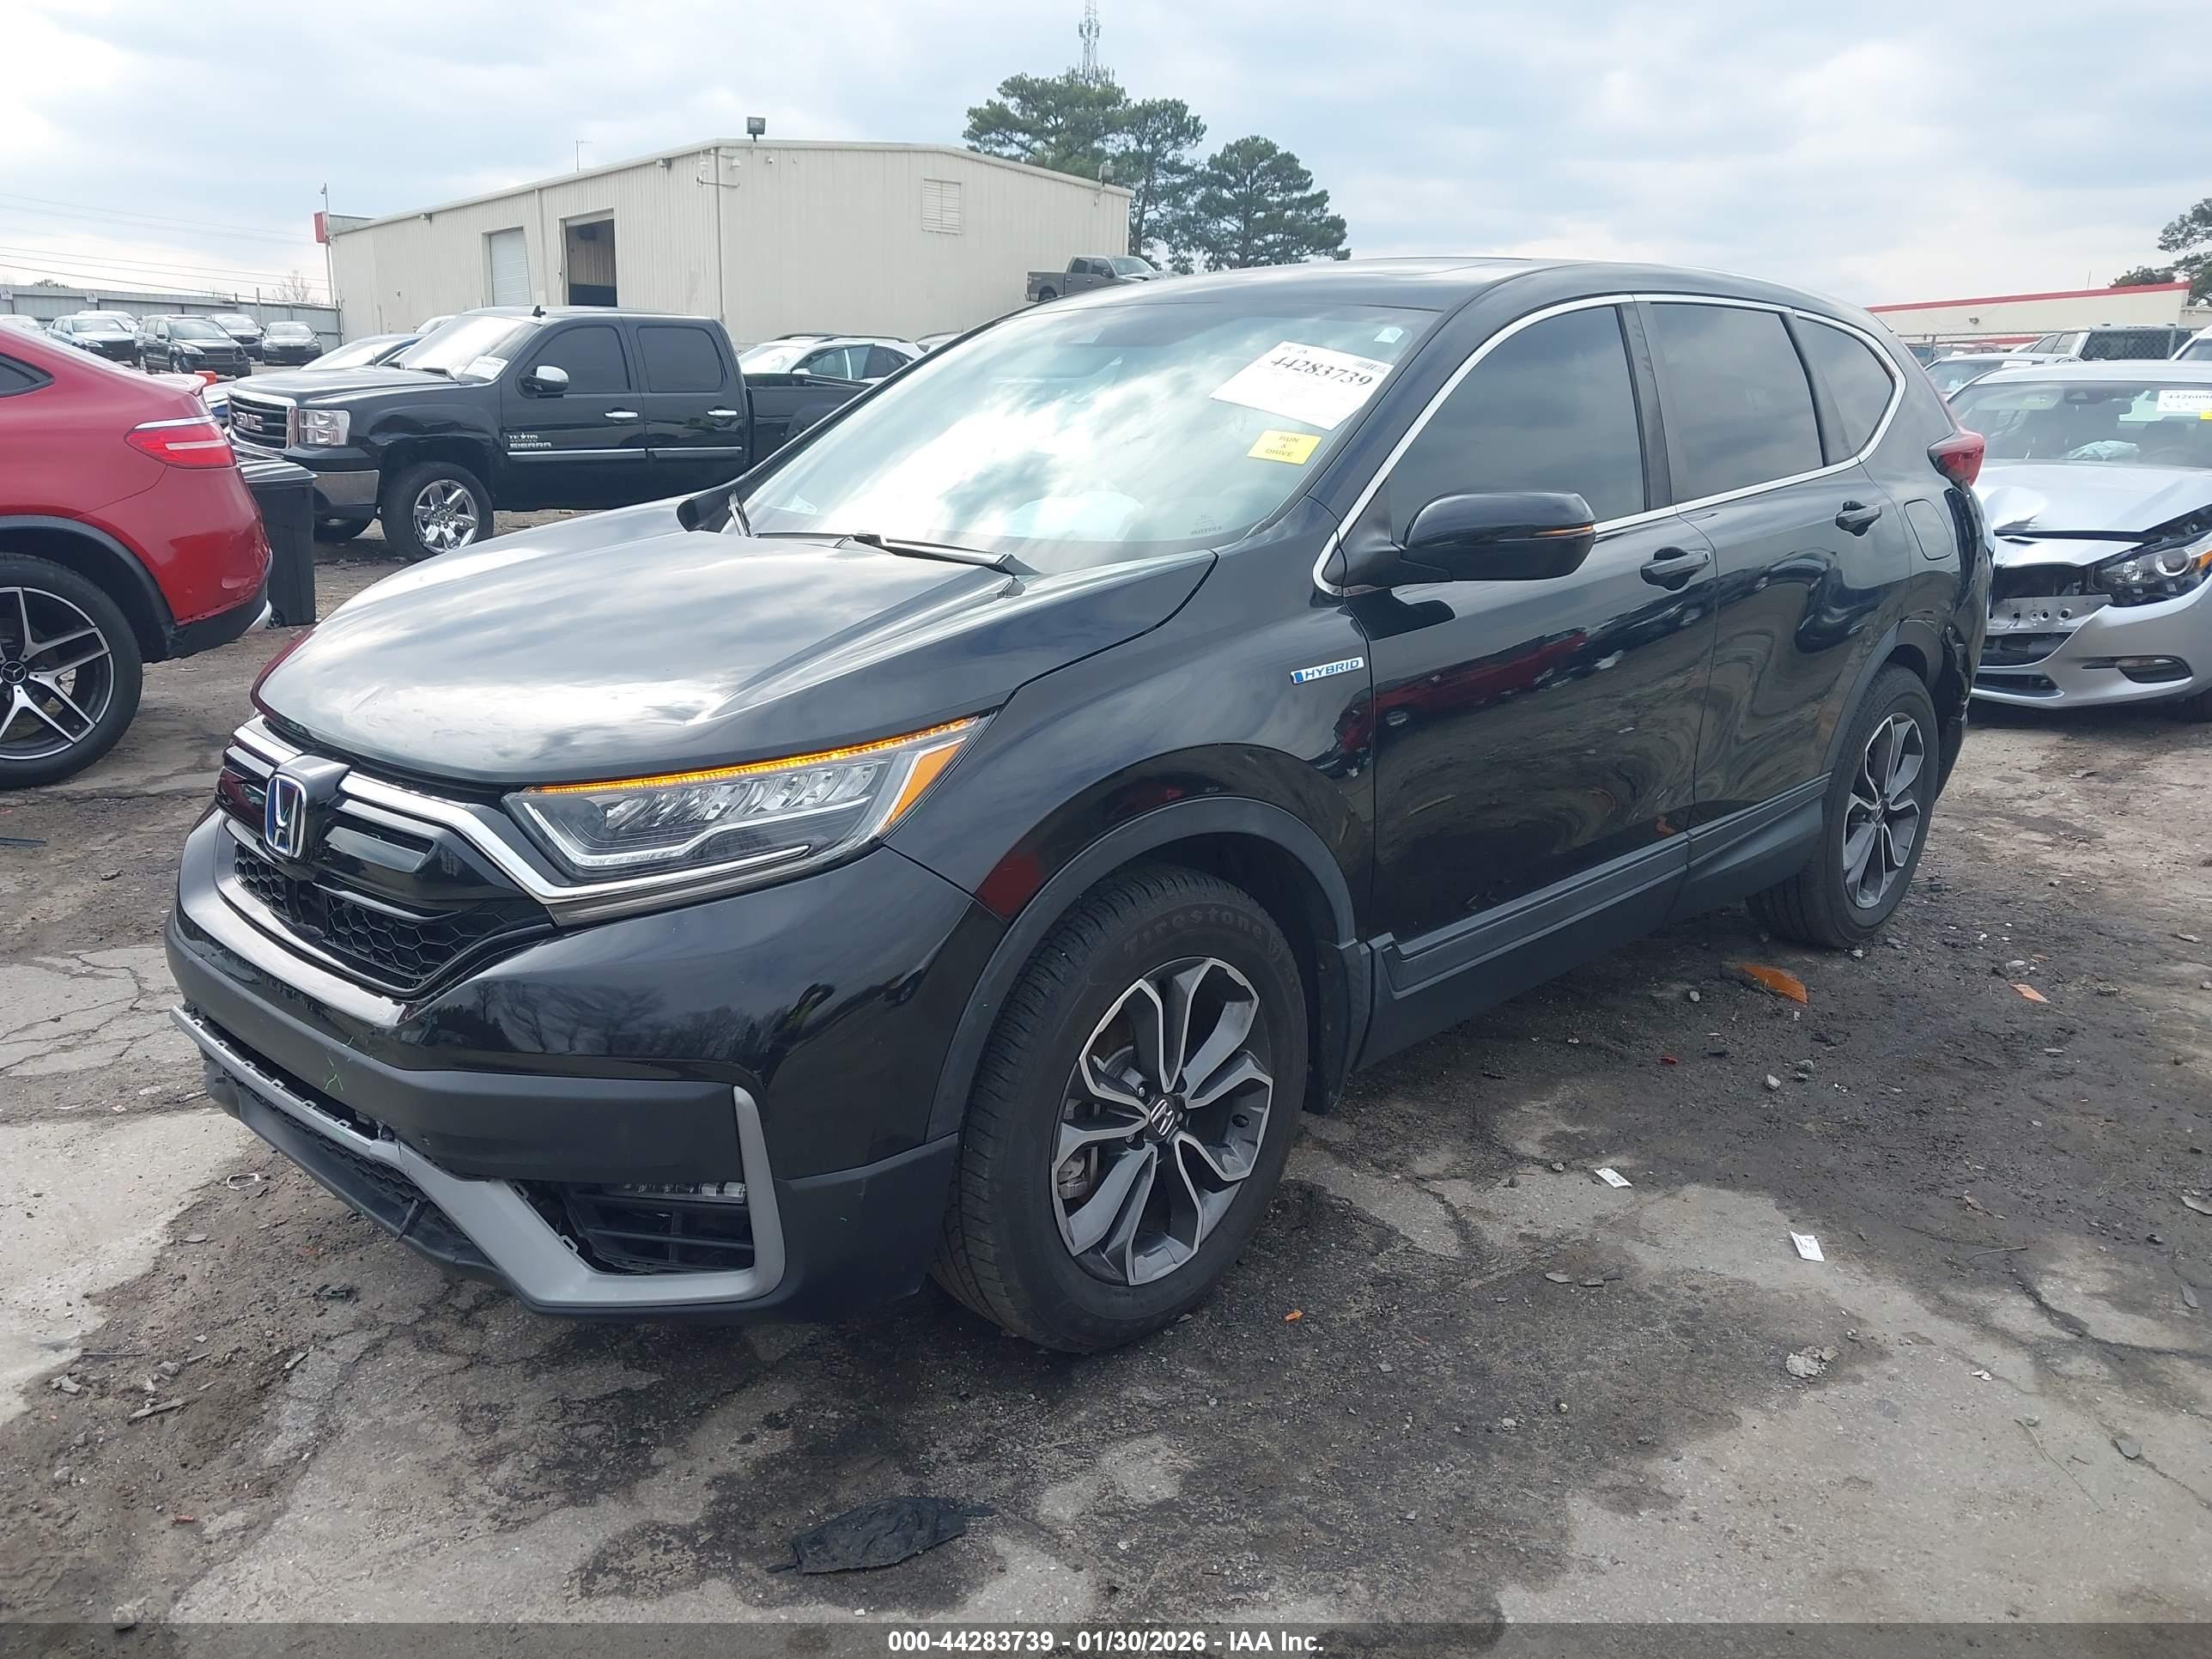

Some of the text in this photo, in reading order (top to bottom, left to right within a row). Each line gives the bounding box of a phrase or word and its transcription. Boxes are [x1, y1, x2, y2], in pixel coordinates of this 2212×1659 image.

[1270, 356, 1374, 386] 44283739
[1264, 448, 1294, 458] DRIVE
[1304, 659, 1359, 680] HYBRID
